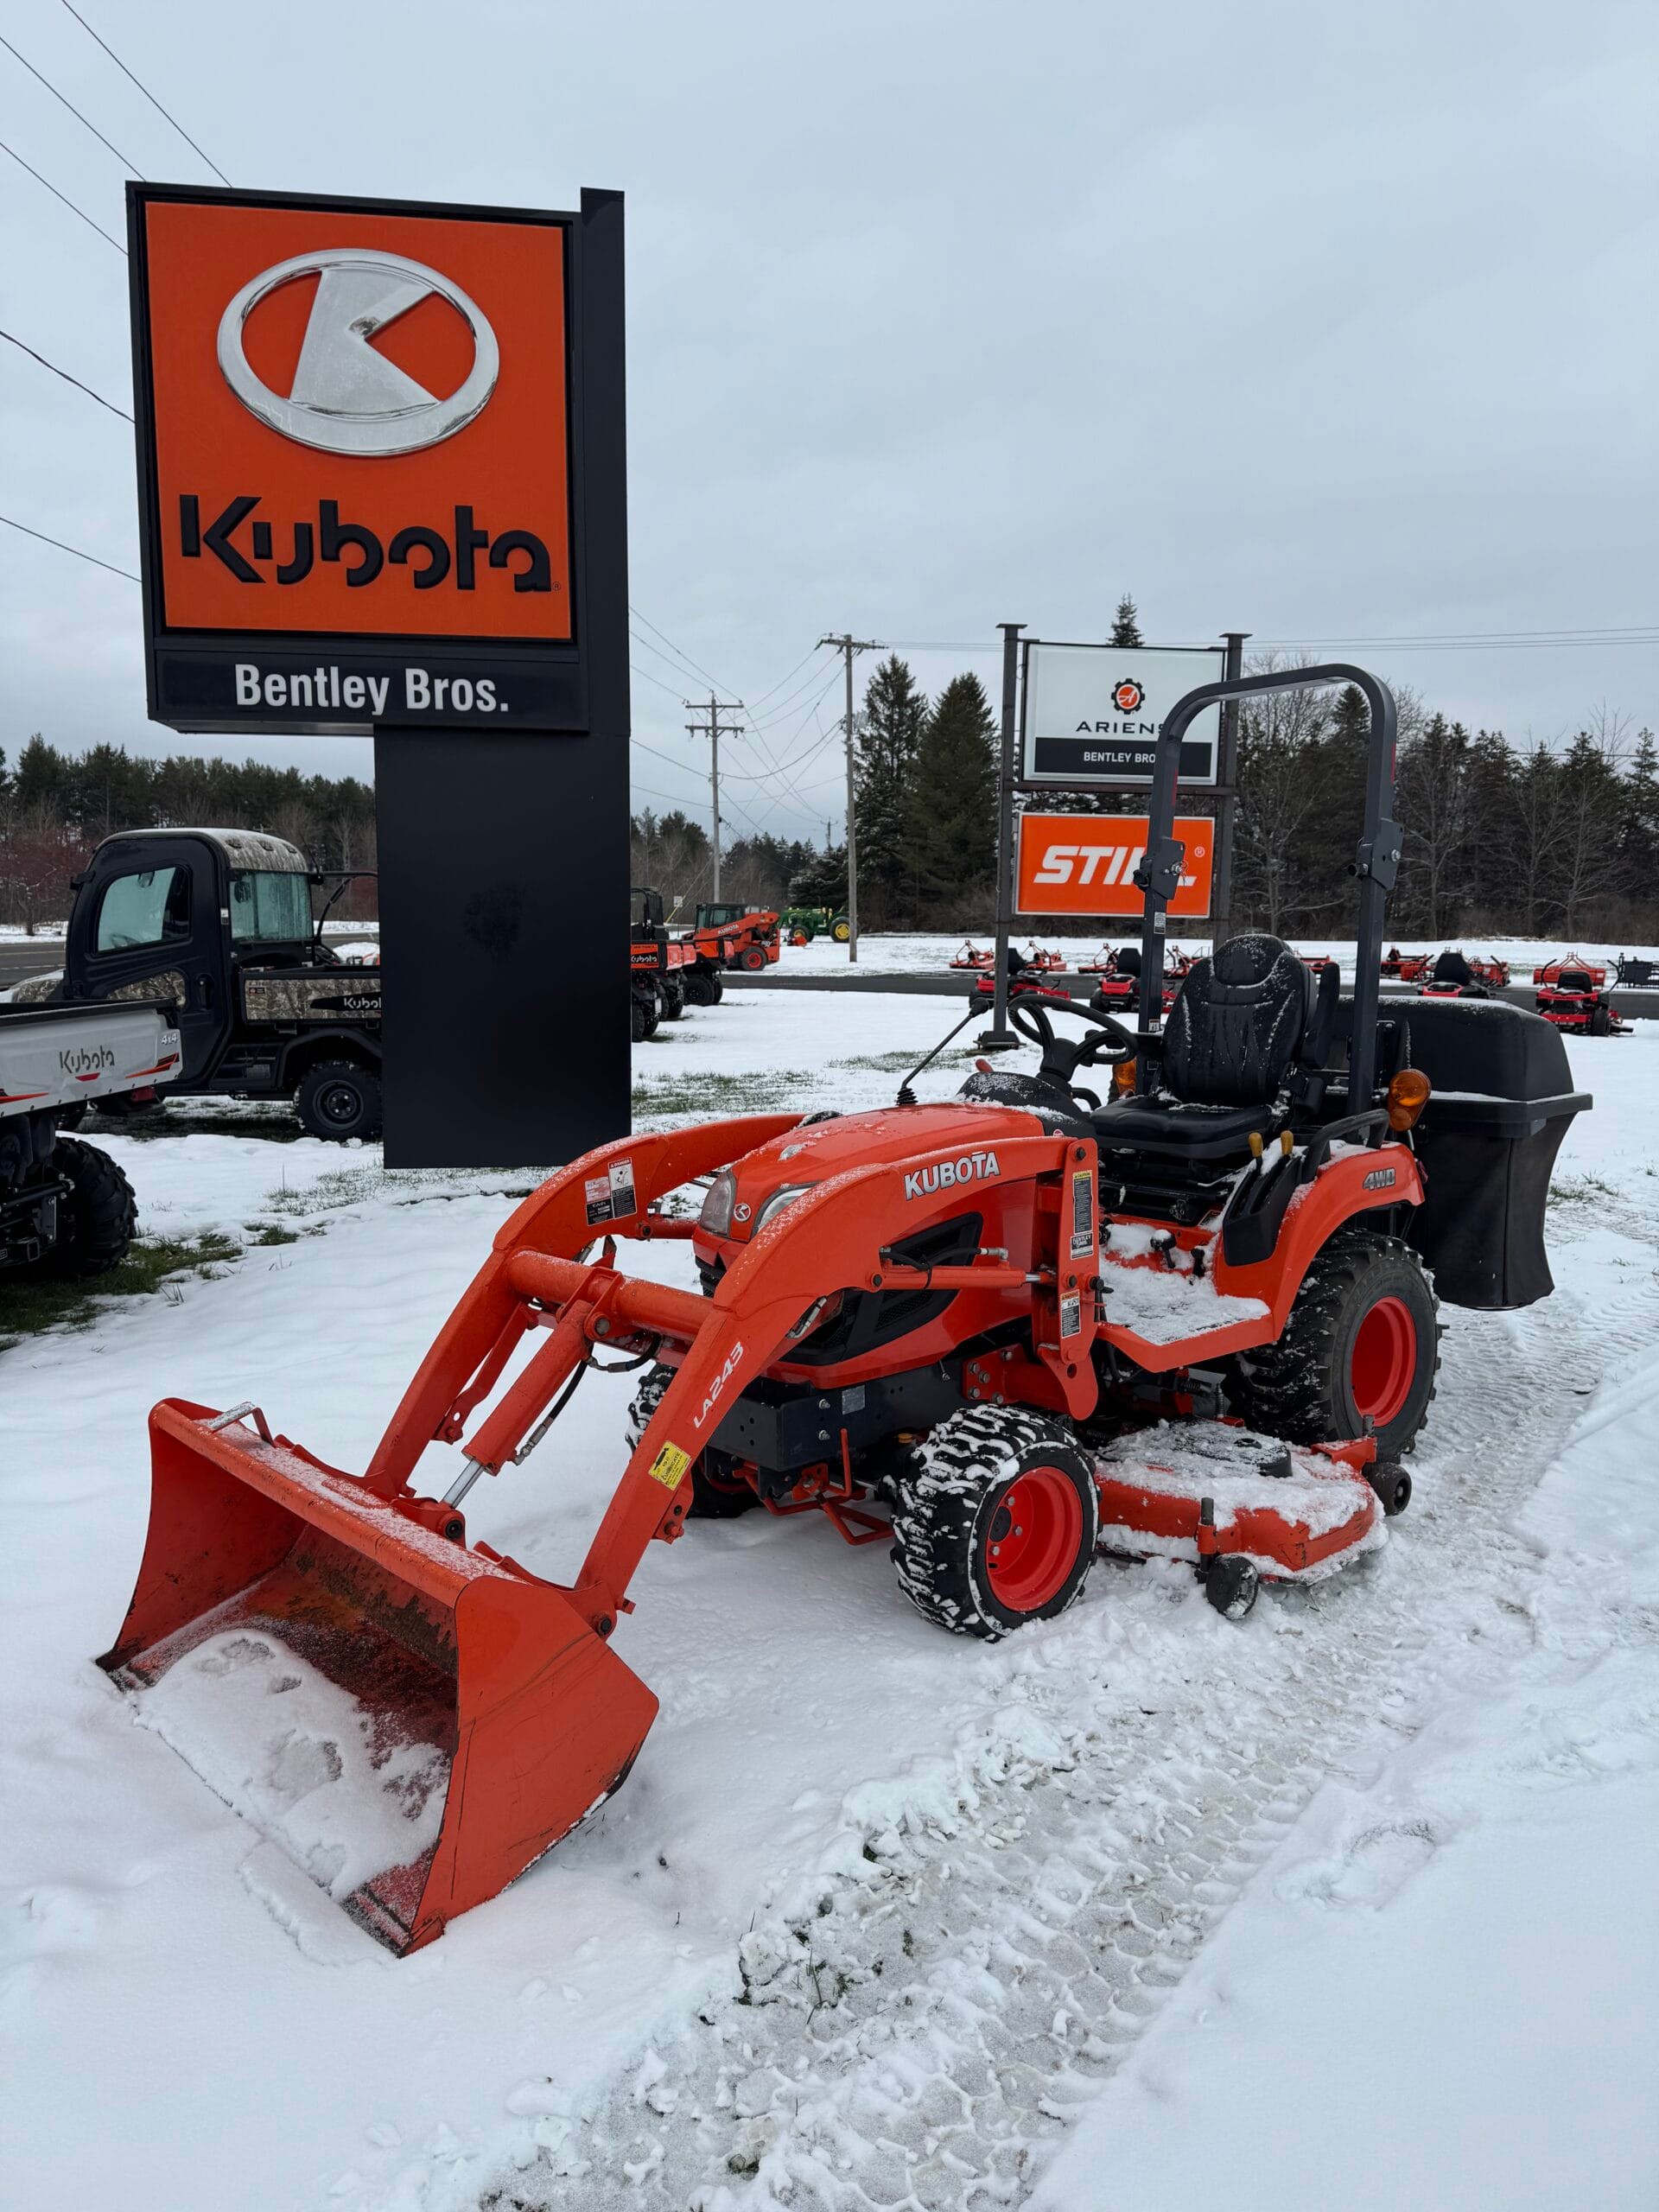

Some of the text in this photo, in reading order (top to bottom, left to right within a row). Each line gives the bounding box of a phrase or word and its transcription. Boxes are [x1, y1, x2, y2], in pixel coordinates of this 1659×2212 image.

[179, 493, 552, 593] Kubota
[234, 663, 509, 716] Bentley Bros.
[1084, 751, 1156, 764] BENTLEY BRO
[1033, 844, 1198, 887] STI
[60, 1045, 115, 1073] Kubota
[162, 1033, 178, 1045] 4x4
[904, 1151, 1001, 1200] KUBOTA
[1363, 1166, 1396, 1191] 4WD
[693, 1341, 743, 1428] LA243
